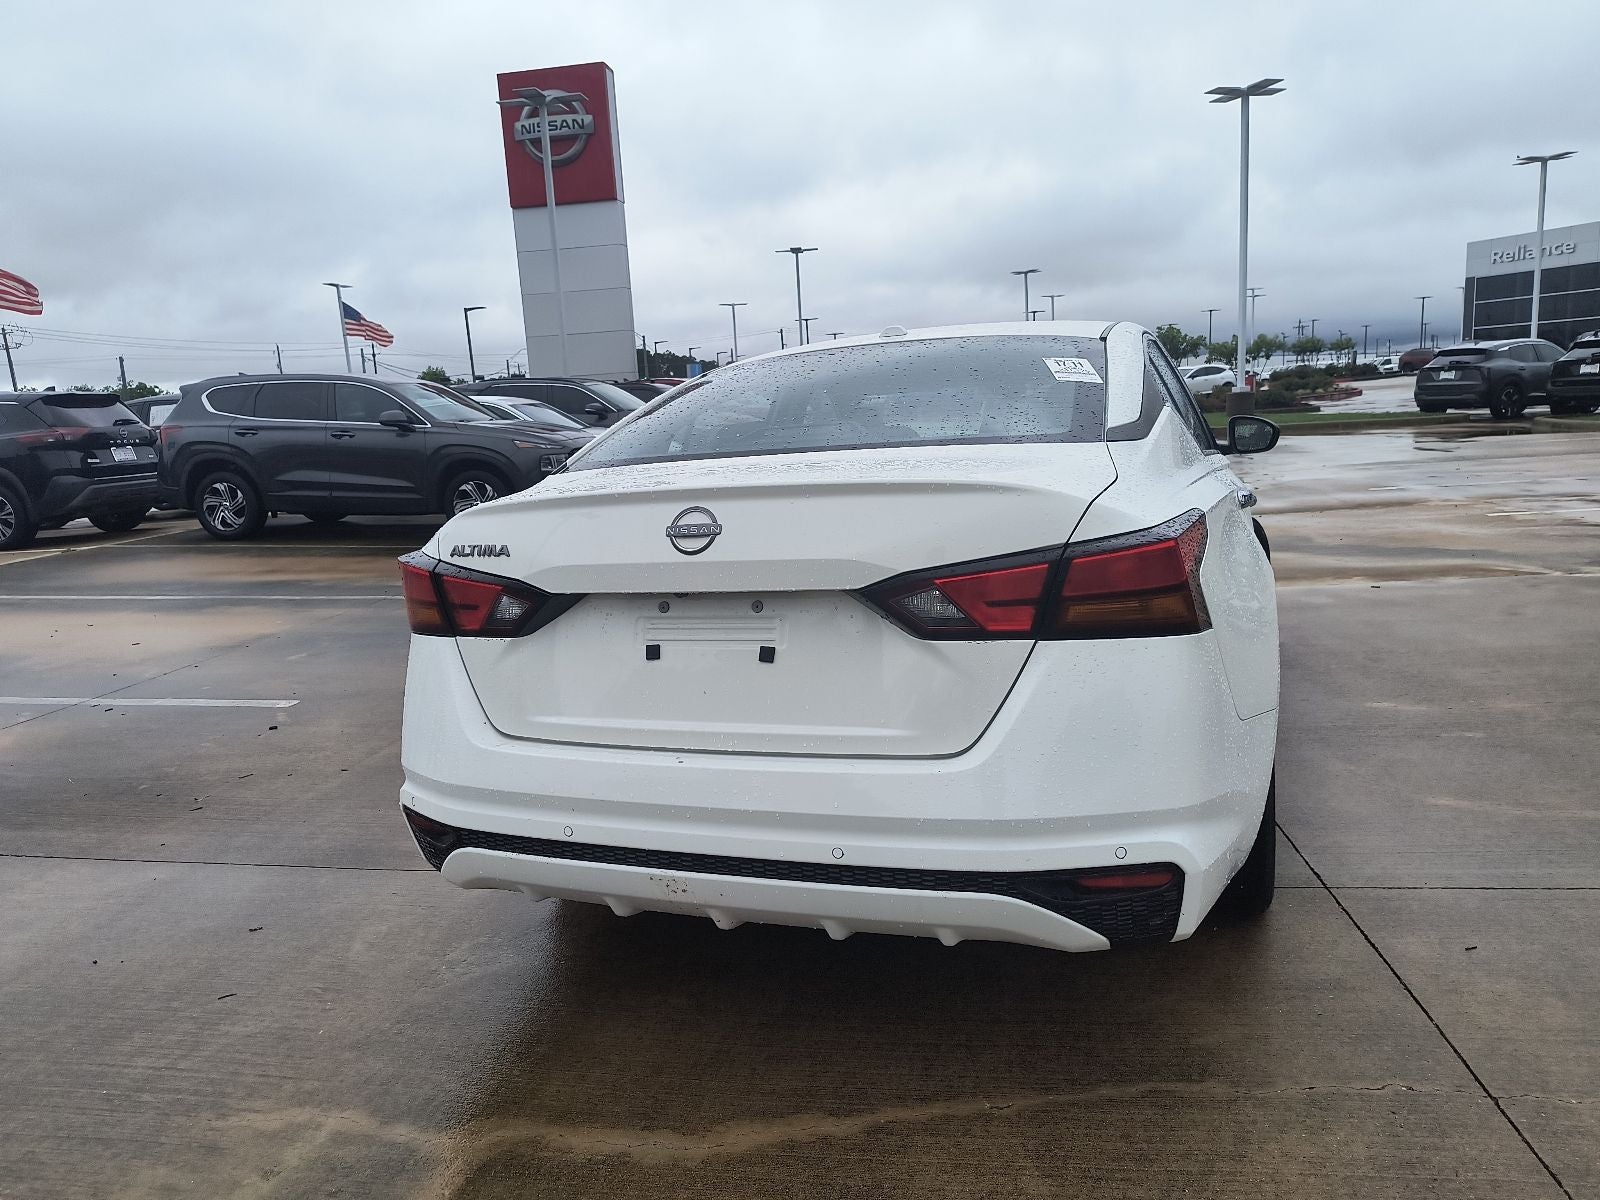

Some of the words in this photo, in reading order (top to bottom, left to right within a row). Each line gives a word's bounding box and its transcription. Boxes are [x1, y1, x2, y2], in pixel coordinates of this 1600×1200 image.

[1490, 240, 1576, 265] Reliance
[666, 525, 720, 535] NISSAN
[449, 544, 511, 558] ALTIMA
